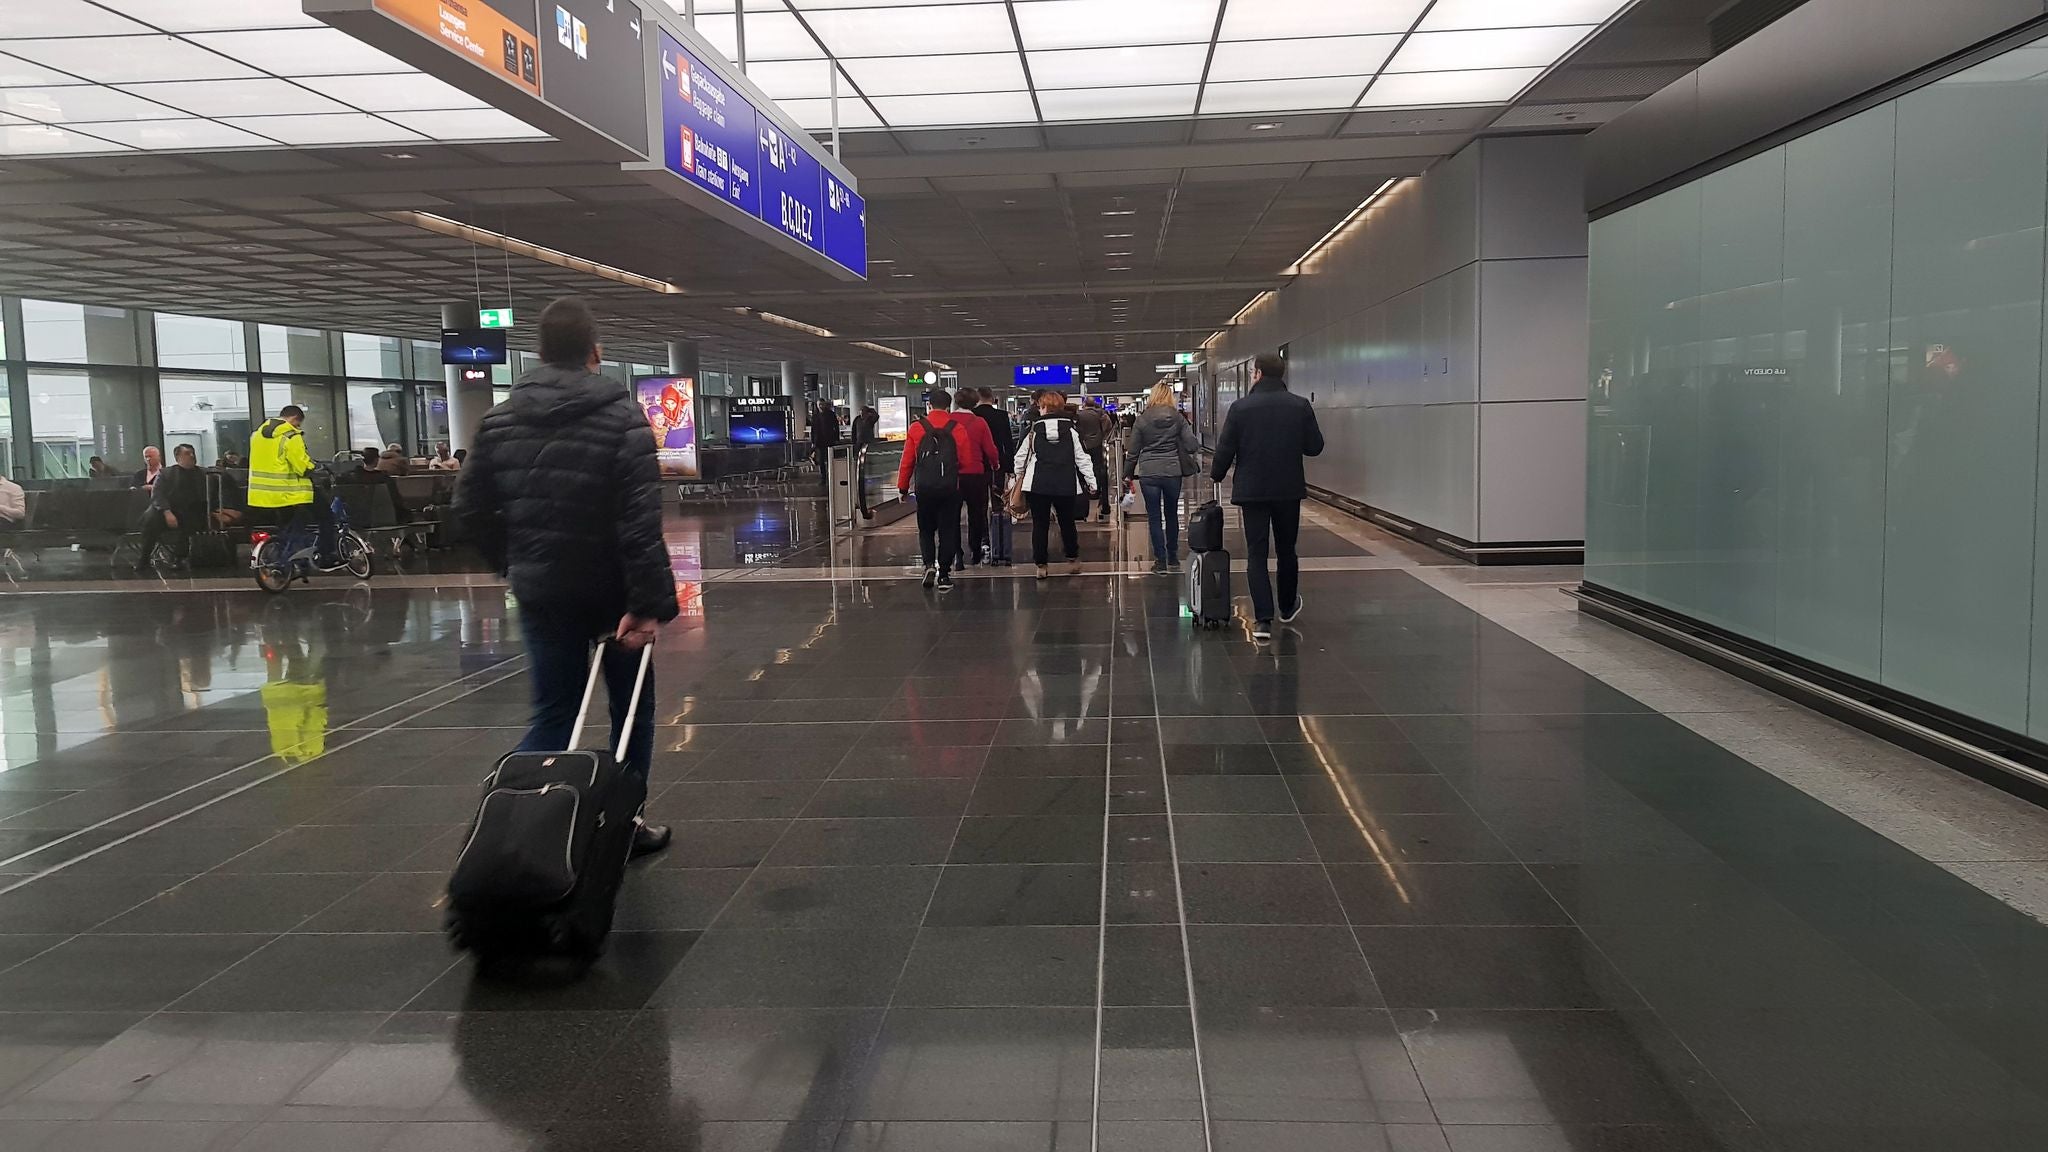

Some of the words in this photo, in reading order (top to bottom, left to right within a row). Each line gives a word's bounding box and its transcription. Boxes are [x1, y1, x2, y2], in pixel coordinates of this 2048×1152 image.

[439, 4, 467, 31] Lounges
[440, 22, 464, 46] Service
[464, 36, 485, 57] Center
[691, 64, 725, 106] Gepäckausgabe
[693, 90, 713, 121] Baggage
[713, 107, 726, 128] claim
[695, 158, 707, 181] Train
[707, 169, 725, 191] stations
[731, 157, 749, 187] Ausgang
[731, 181, 741, 200] Exit
[738, 398, 747, 406] LG
